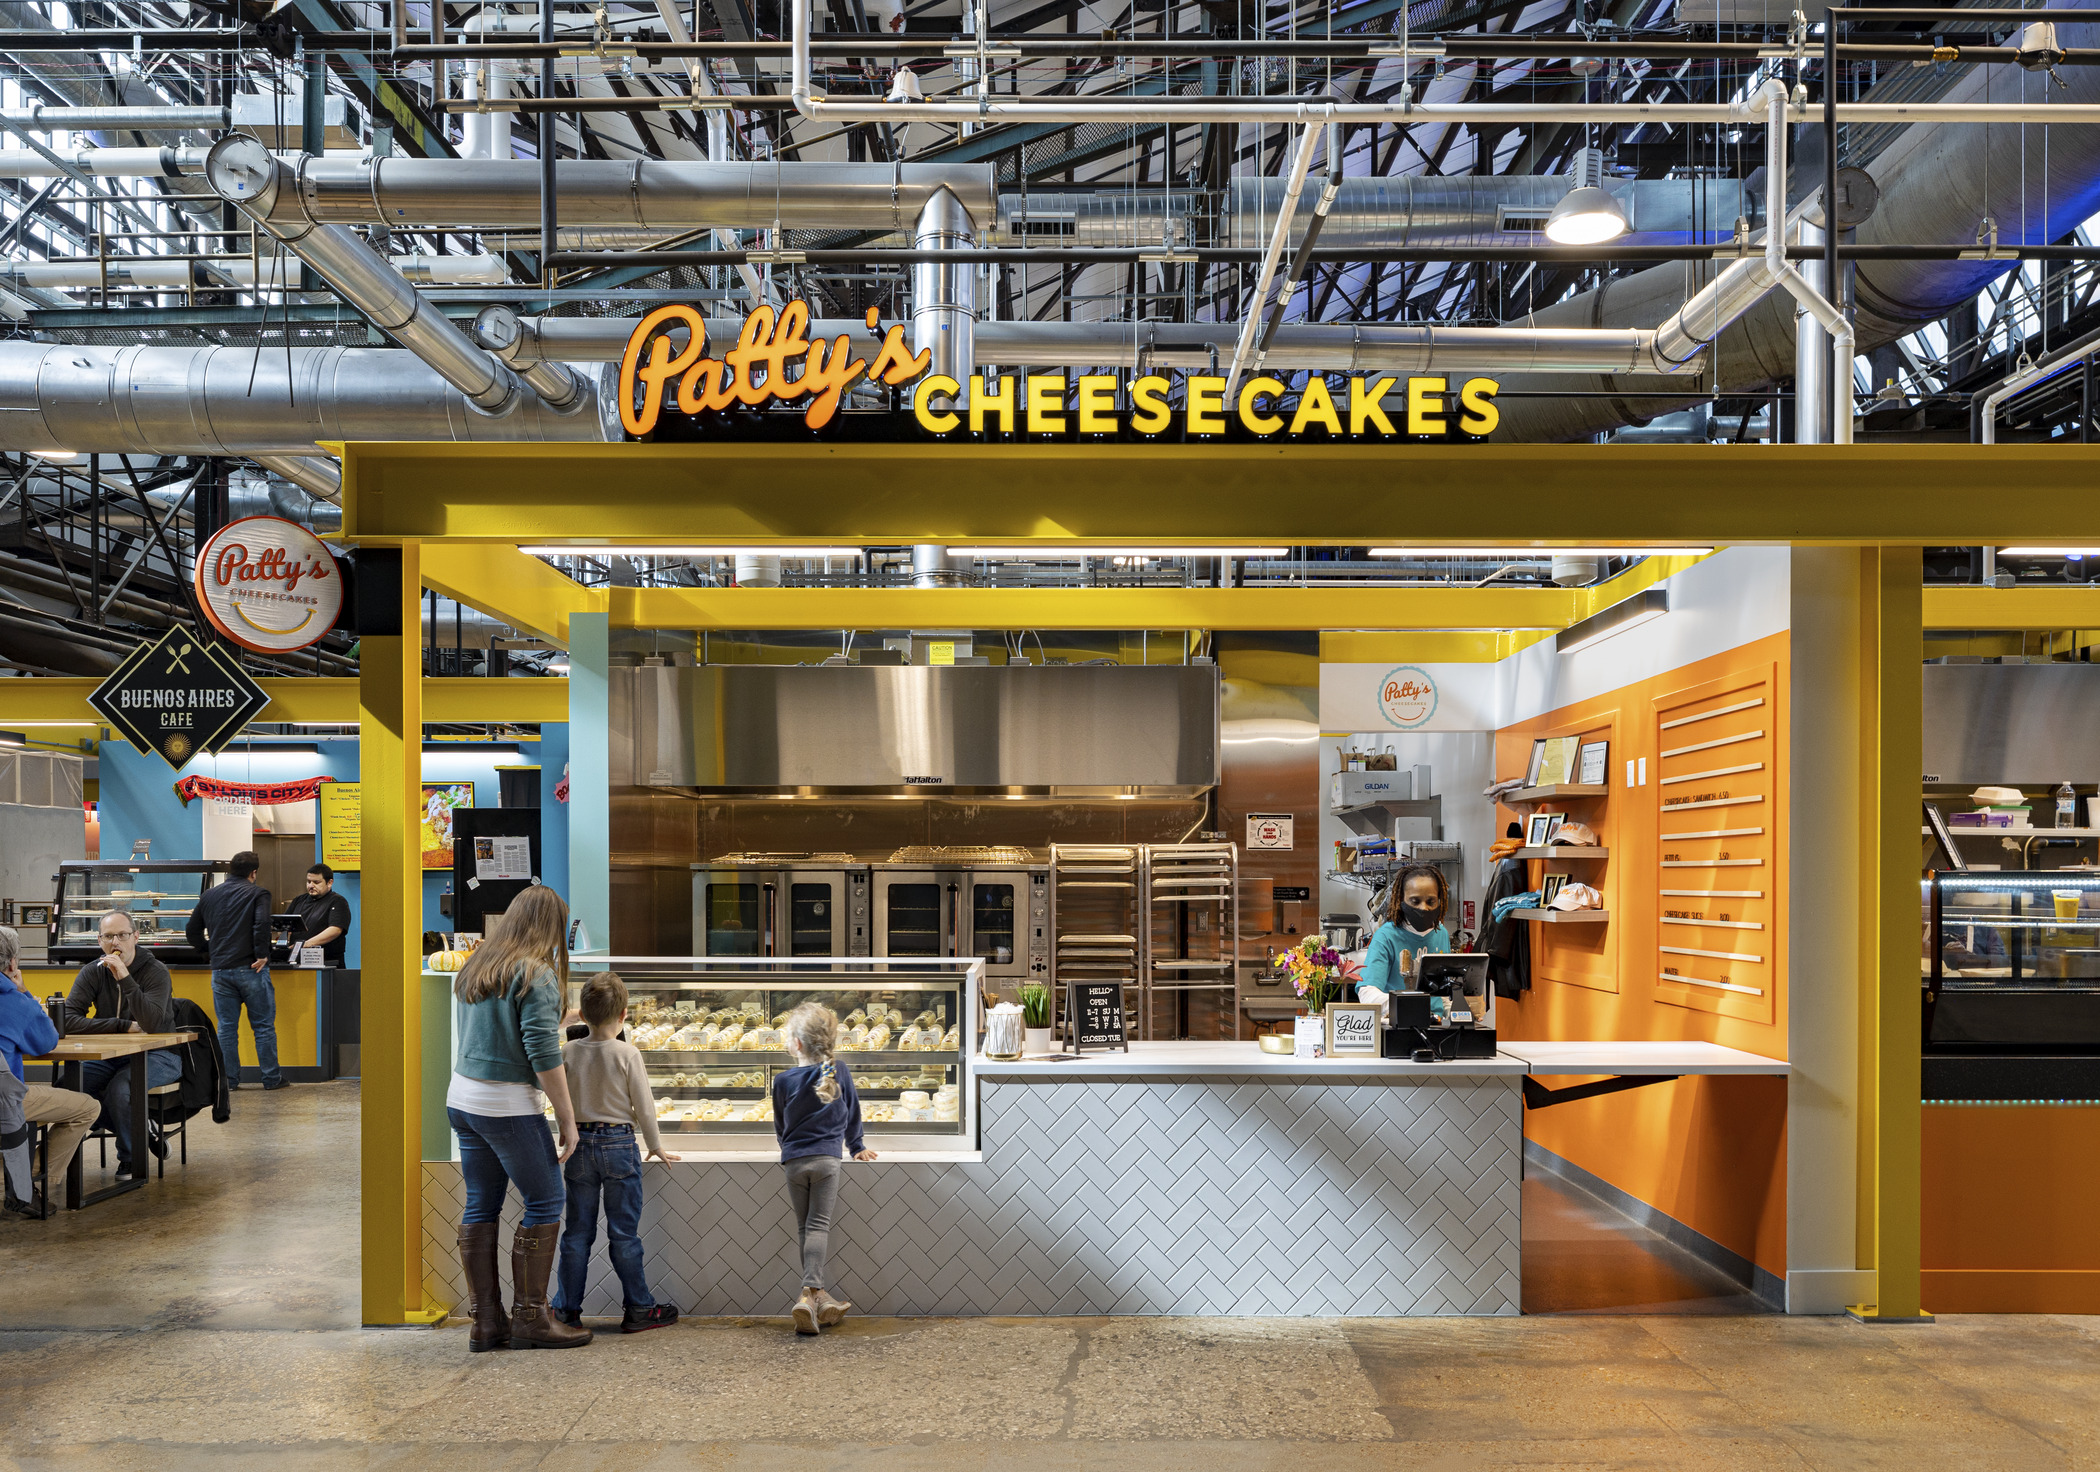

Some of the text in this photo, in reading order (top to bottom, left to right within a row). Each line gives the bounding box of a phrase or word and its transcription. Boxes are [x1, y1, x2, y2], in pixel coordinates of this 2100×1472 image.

[618, 300, 932, 435] Patty's
[914, 375, 1500, 434] CHEESECAKES
[216, 543, 330, 591] Patty's
[230, 588, 319, 605] CHEESECAKES
[1384, 680, 1432, 702] Patty's
[120, 689, 235, 708] BUENOS AIRES
[160, 712, 193, 726] CAFE
[221, 786, 268, 799] LOUIS
[271, 785, 306, 798] CITY
[213, 796, 252, 806] ORDER
[1664, 796, 1691, 806] CHEESECAKE
[1692, 793, 1717, 803] SANDWICH
[218, 806, 247, 815] HERE
[1664, 966, 1679, 976] WATER
[1089, 998, 1108, 1006] OPEN
[1335, 1014, 1374, 1035] Glad
[1081, 1034, 1121, 1043] CLOSED TUE
